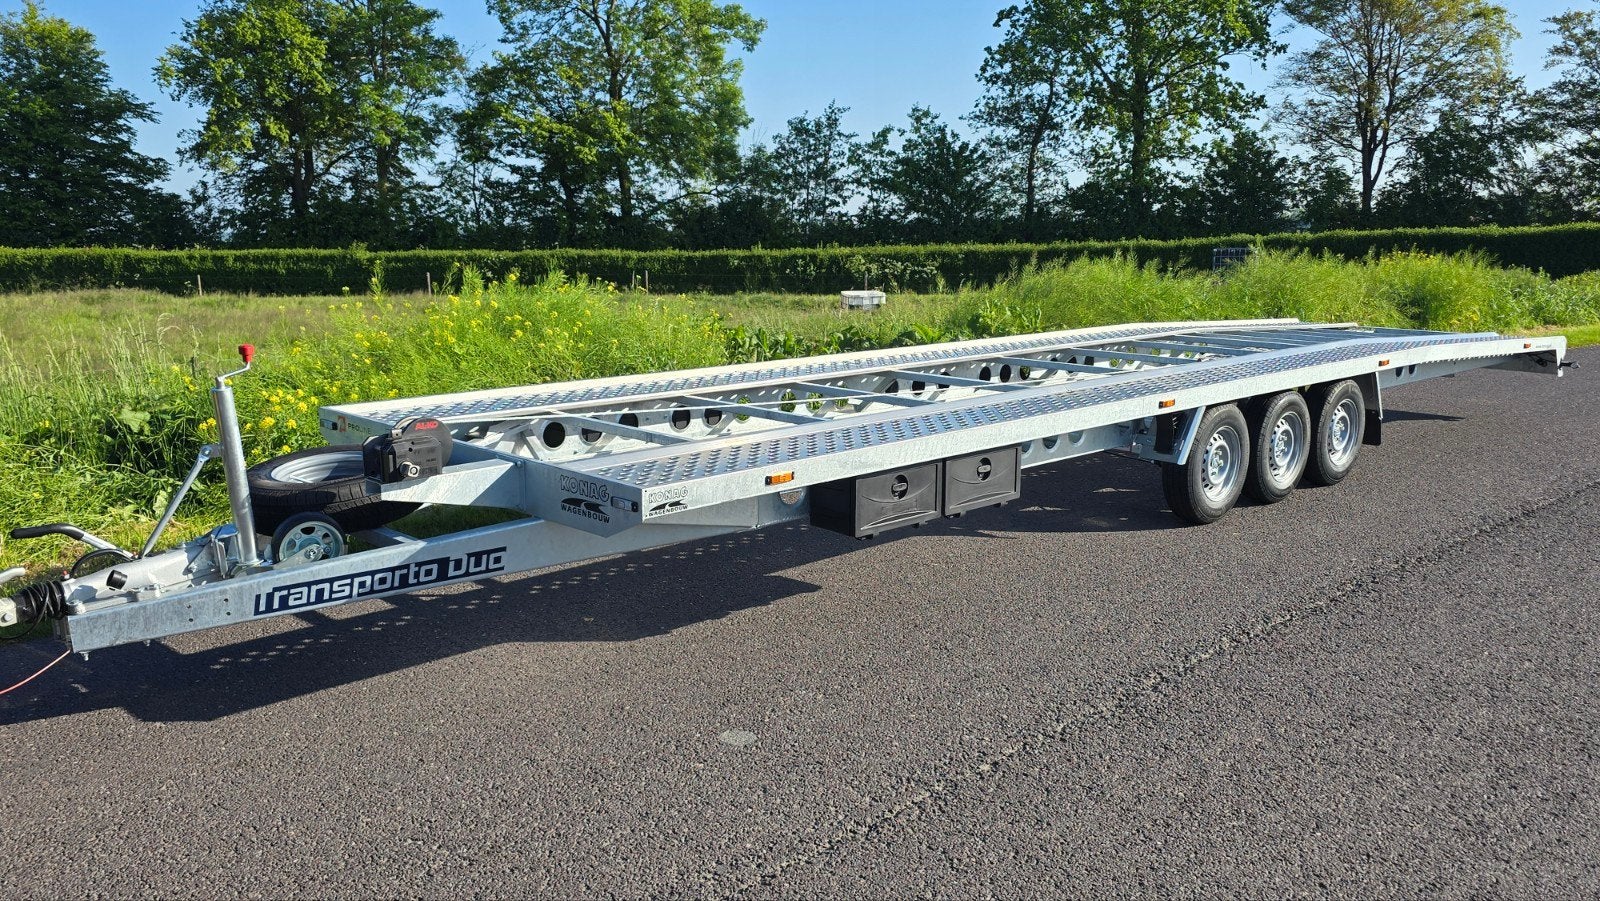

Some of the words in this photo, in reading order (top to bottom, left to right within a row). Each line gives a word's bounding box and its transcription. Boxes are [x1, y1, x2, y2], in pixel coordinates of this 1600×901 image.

[347, 422, 371, 435] PROLINE
[560, 474, 609, 502] KONAG
[648, 486, 688, 504] KONAG
[560, 503, 610, 524] WAGENBOUW
[648, 504, 688, 517] WAGENBOUW
[255, 561, 438, 612] Transporto
[448, 550, 507, 578] Duo
